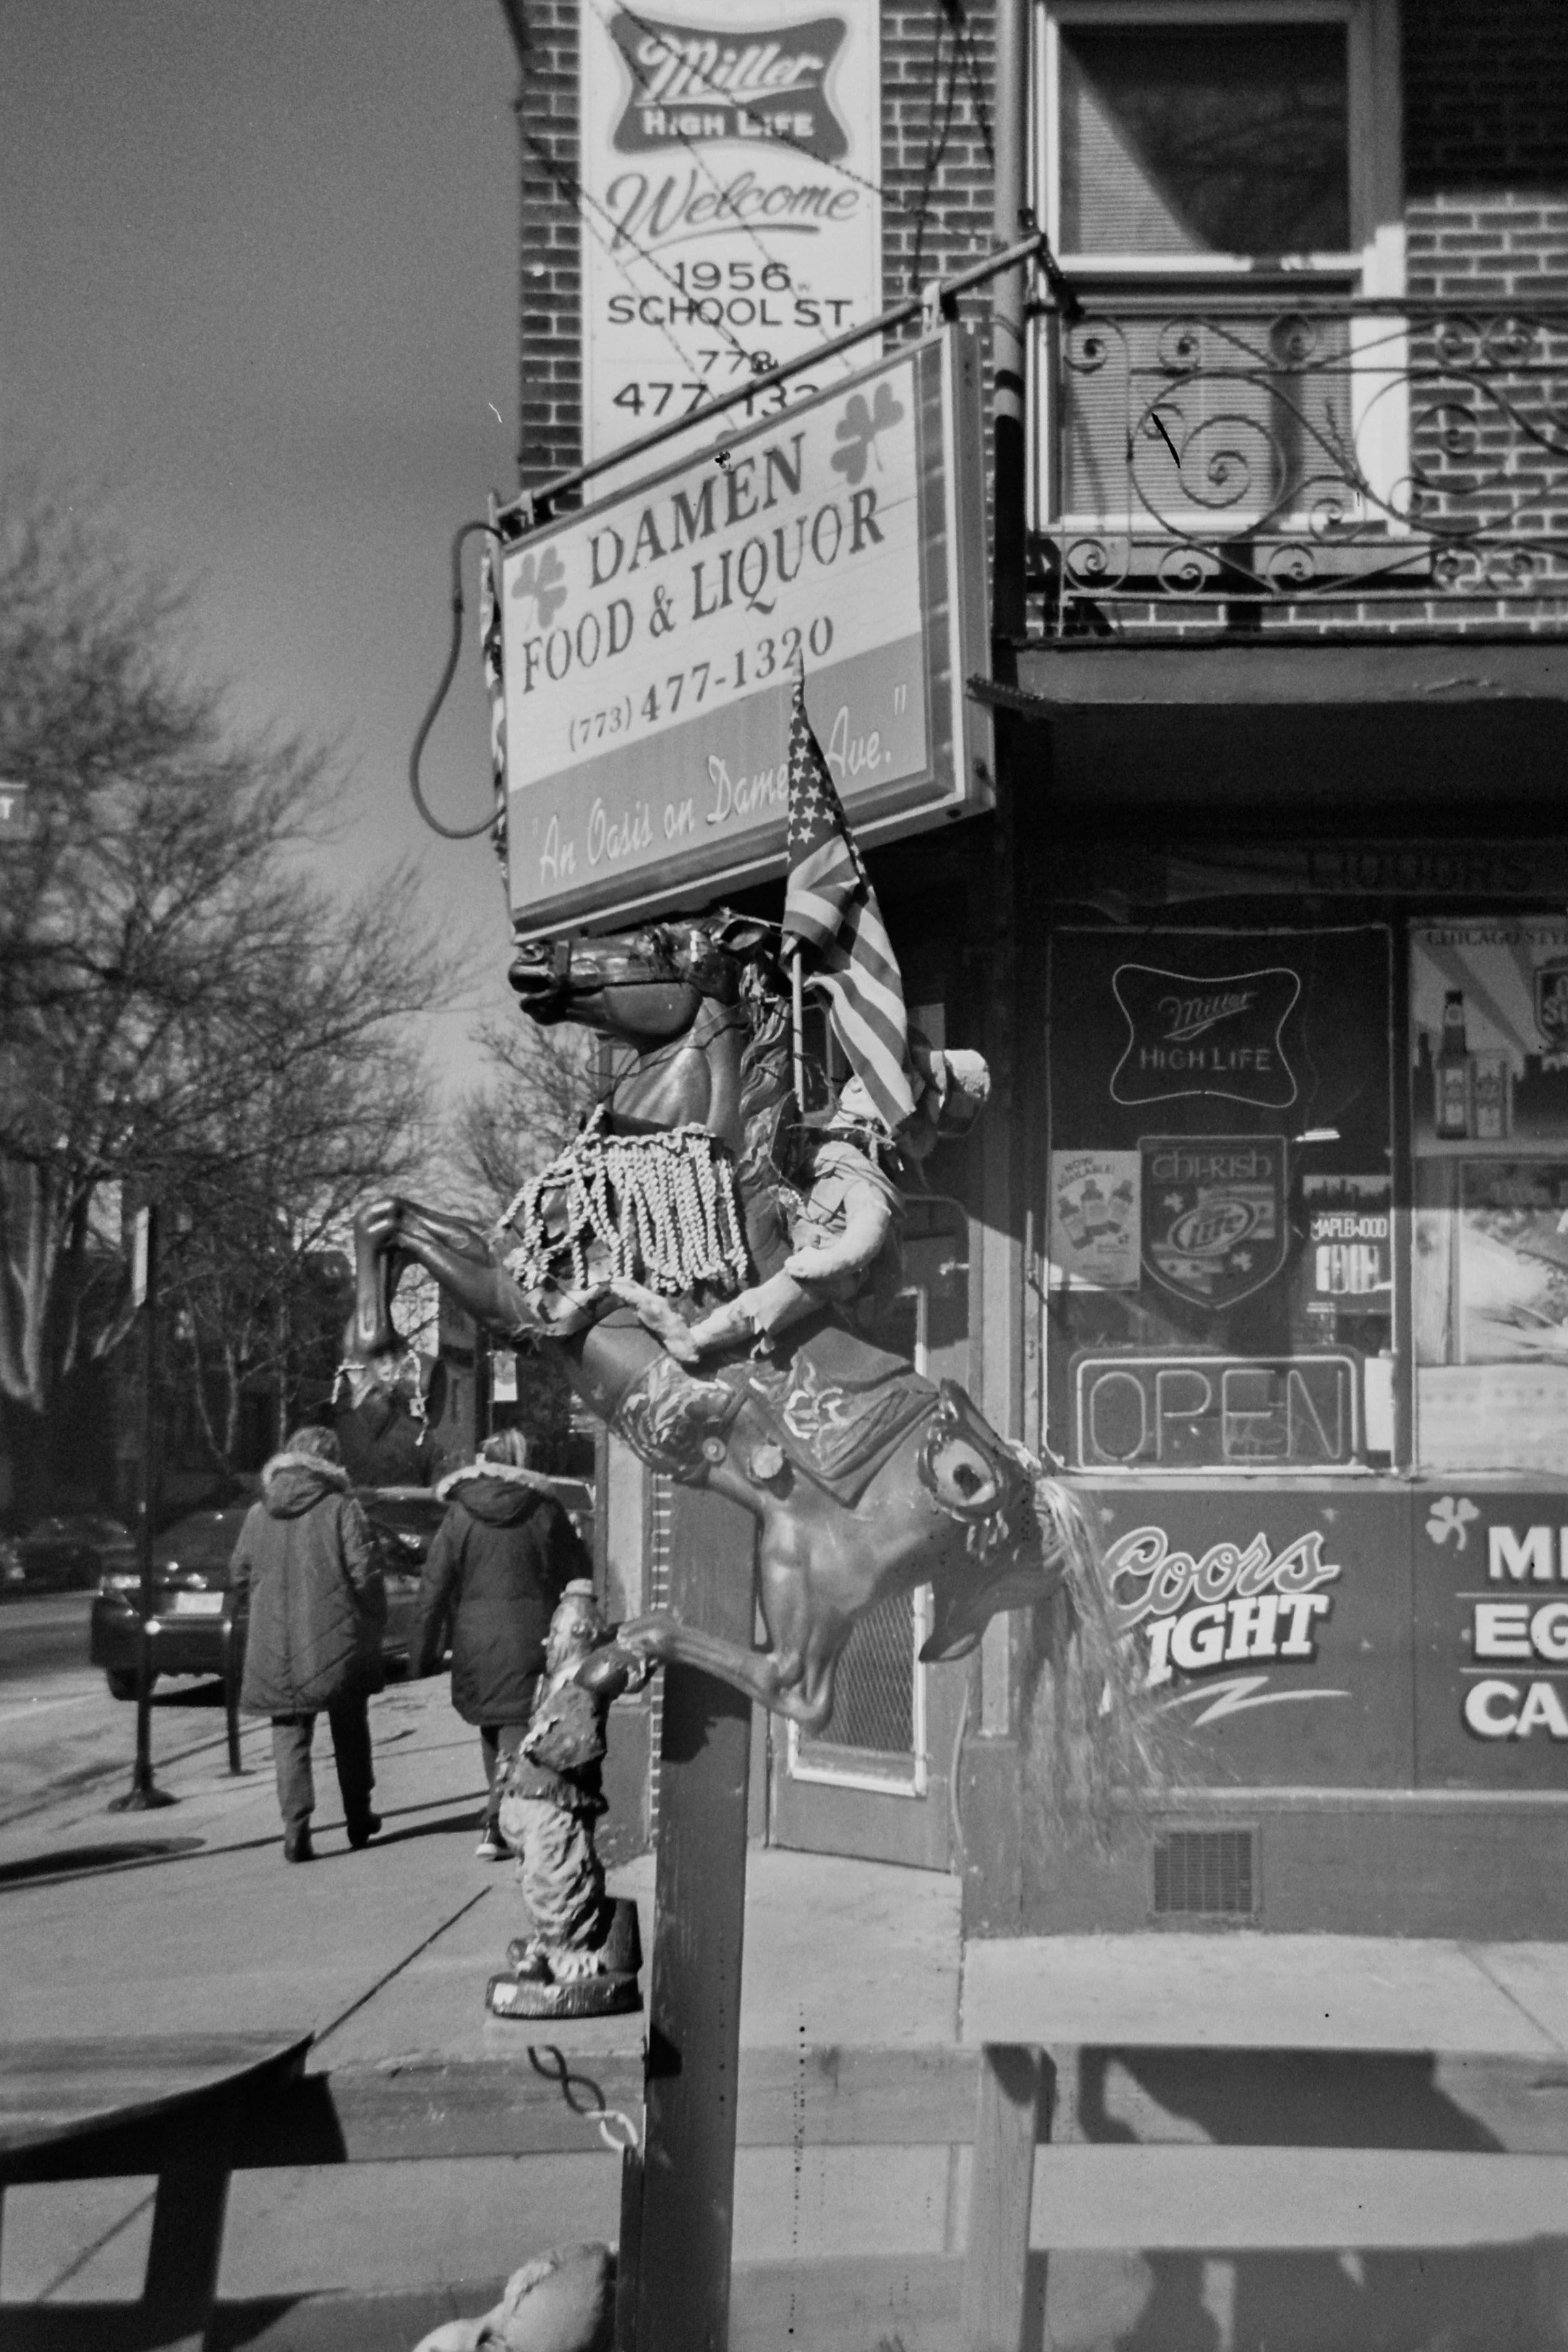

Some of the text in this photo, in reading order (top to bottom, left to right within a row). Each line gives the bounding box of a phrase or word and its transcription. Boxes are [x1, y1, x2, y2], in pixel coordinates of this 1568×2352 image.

[638, 34, 823, 99] Miller
[644, 110, 814, 137] HIGH LIFE
[606, 169, 859, 253] Welcome
[608, 295, 783, 326] SCHOOL
[674, 262, 791, 292] 1956
[589, 433, 806, 589] DAMEN
[522, 486, 885, 695] FOOD & LIQUOR
[569, 615, 834, 752] (773) 477-1320
[589, 798, 653, 866] Oasis
[664, 796, 695, 840] on
[706, 755, 789, 825] Dame
[1158, 991, 1258, 1028] Miller
[1140, 1047, 1271, 1070] HIGH LIFE
[1310, 1218, 1387, 1241] MAPLEWOOD
[1089, 1368, 1345, 1461] OPEN
[1102, 1526, 1341, 1629] Coors
[1119, 1594, 1329, 1692] IGHT
[1464, 1679, 1568, 1738] CA
